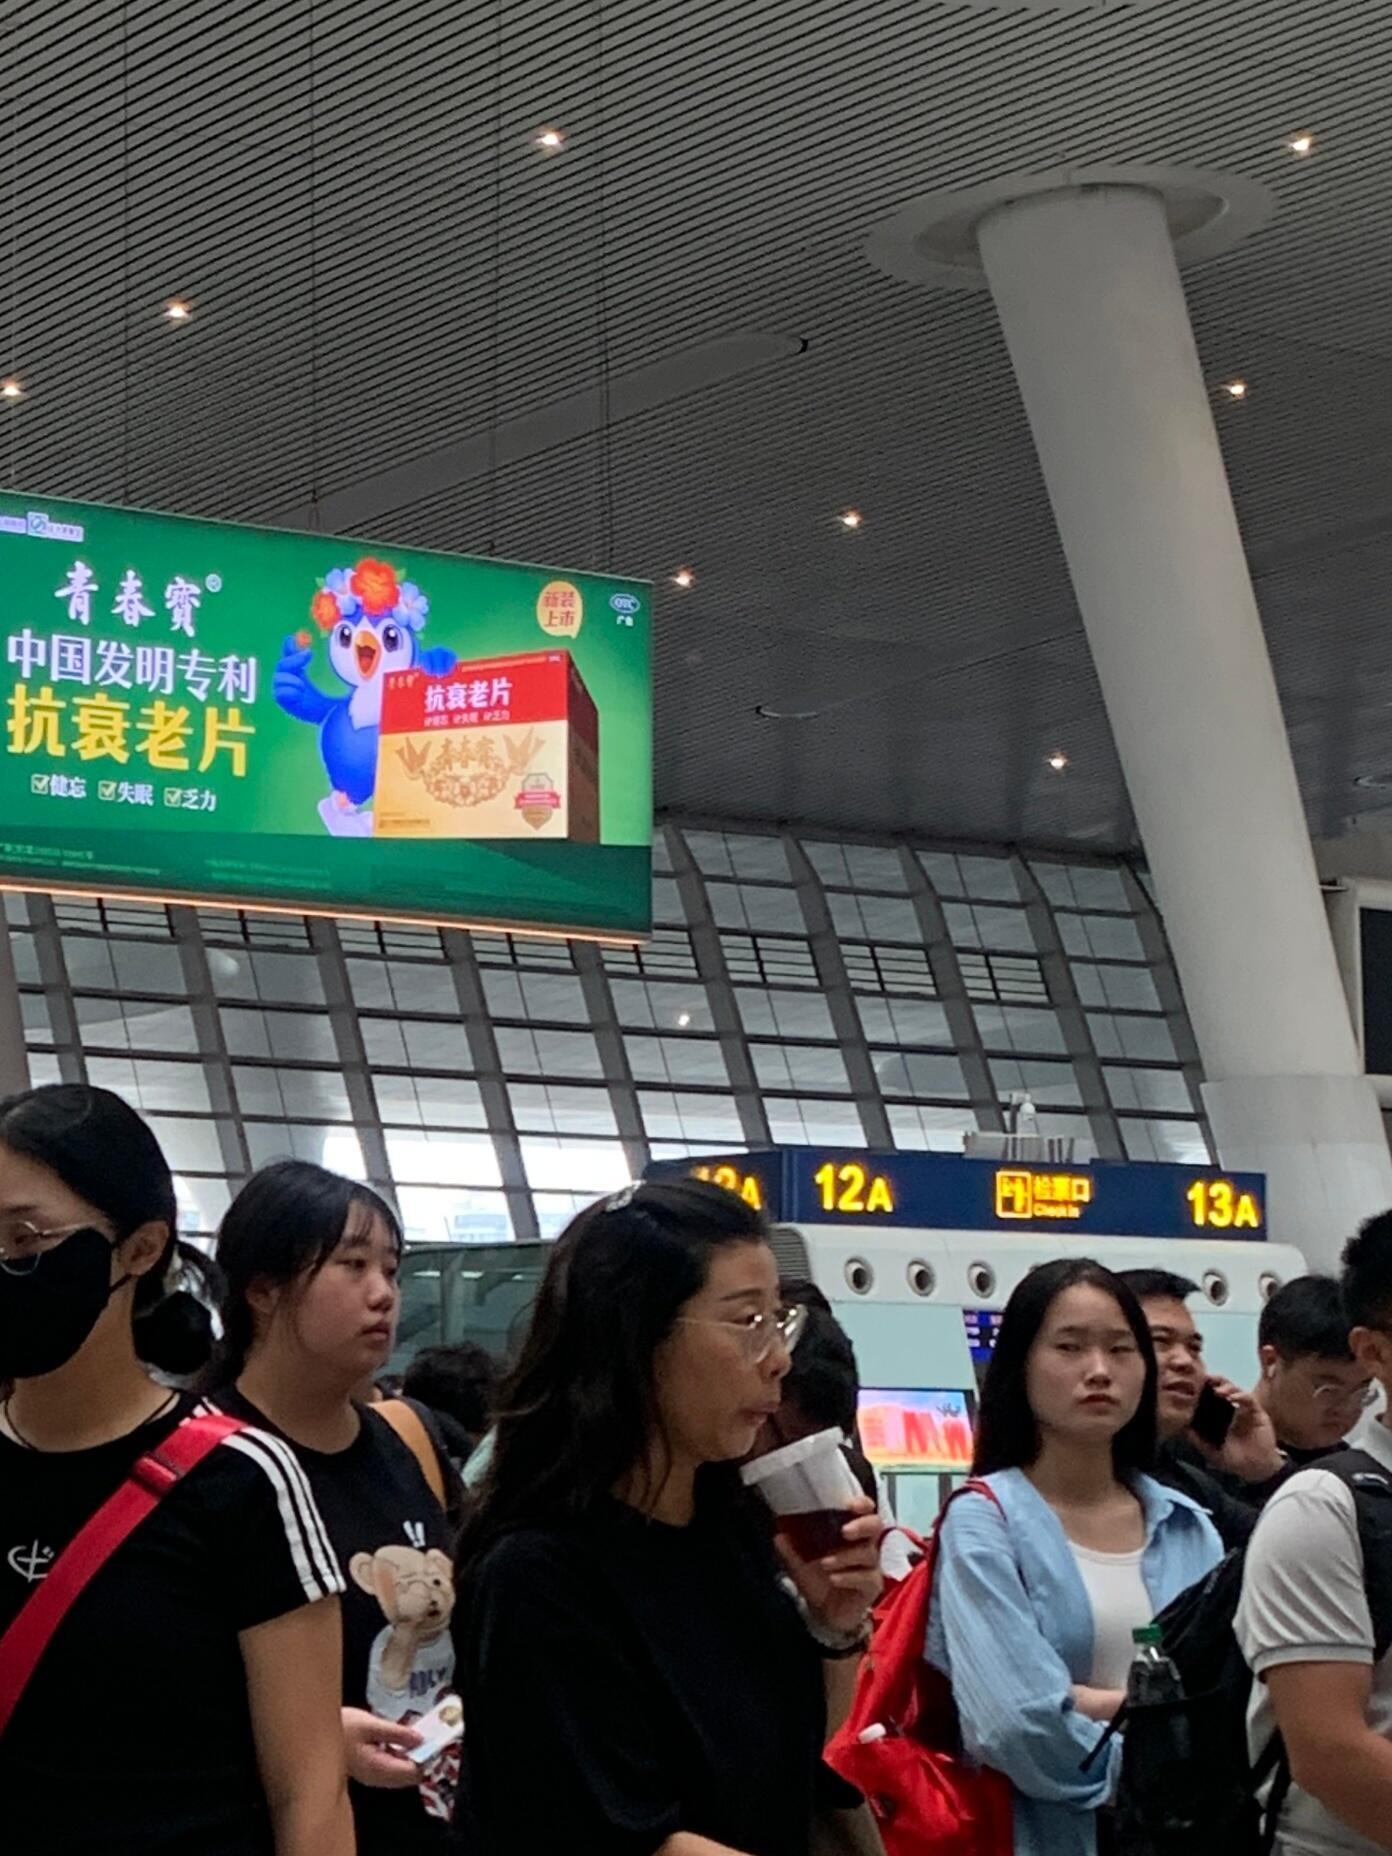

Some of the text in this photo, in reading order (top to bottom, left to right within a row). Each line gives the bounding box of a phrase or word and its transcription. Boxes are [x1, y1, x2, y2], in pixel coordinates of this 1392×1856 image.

[7, 628, 257, 704] 中国发明专利
[424, 677, 512, 713] 抗衰老片
[7, 683, 256, 777] 抗衰老片
[50, 774, 217, 812] 健忘 失眠 乏力
[814, 1163, 894, 1213] 12A
[1187, 1181, 1259, 1228] 13A
